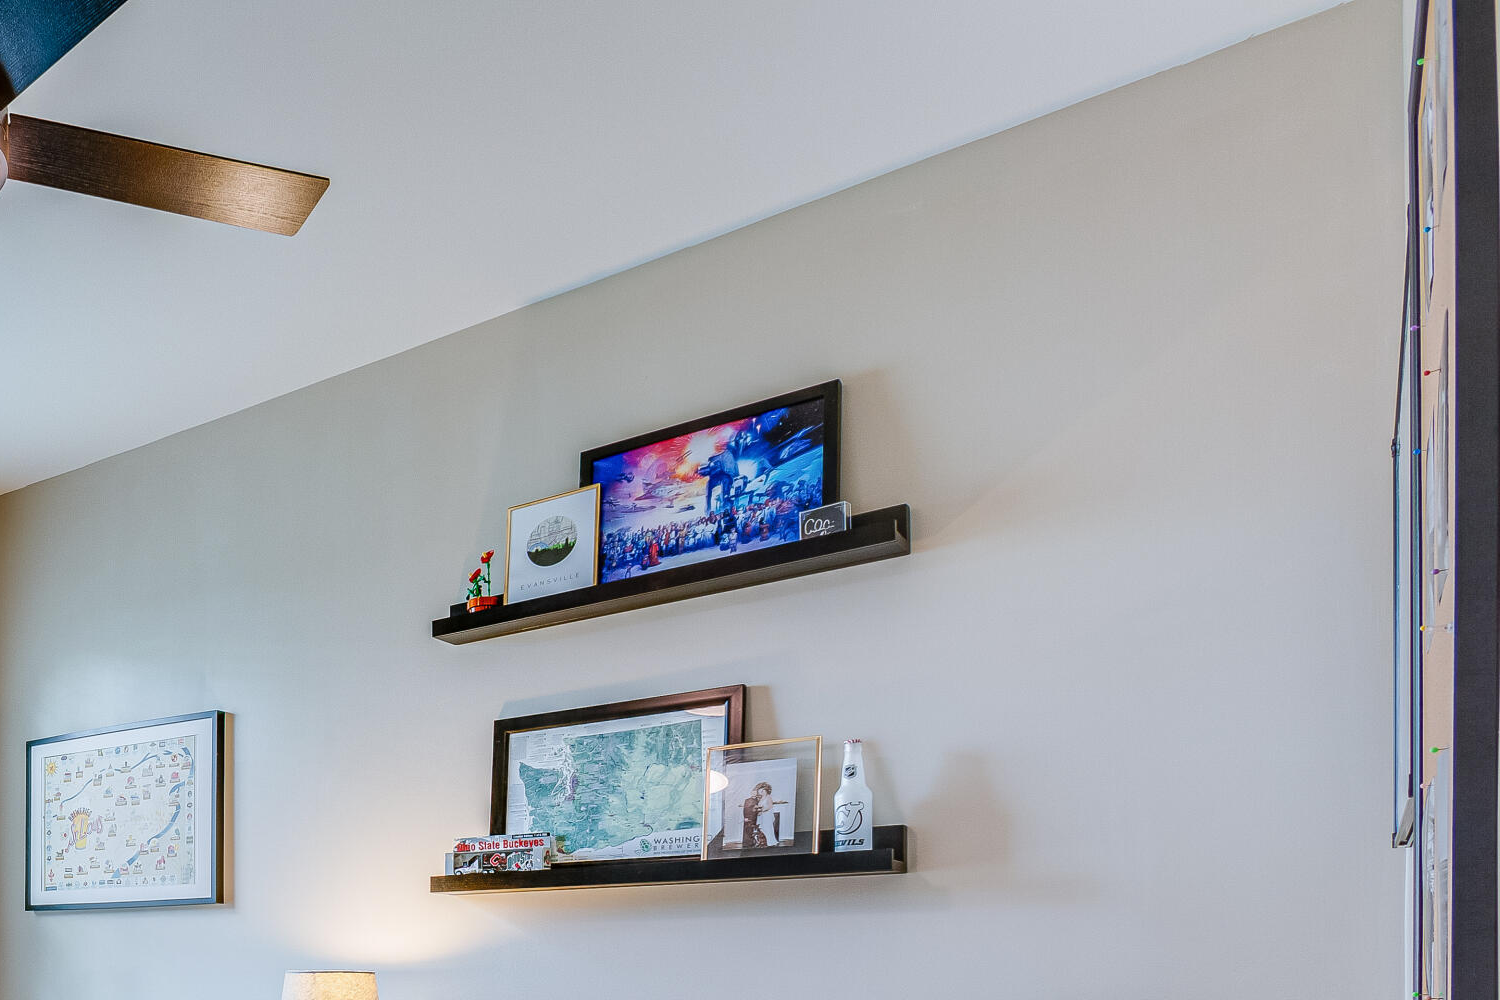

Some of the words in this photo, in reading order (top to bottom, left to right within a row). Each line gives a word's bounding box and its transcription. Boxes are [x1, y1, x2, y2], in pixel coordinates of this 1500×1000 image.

[520, 572, 580, 591] EVANSVILLE
[478, 840, 500, 850] State
[503, 838, 544, 849] Buckeyes
[653, 835, 713, 845] WASHINGO
